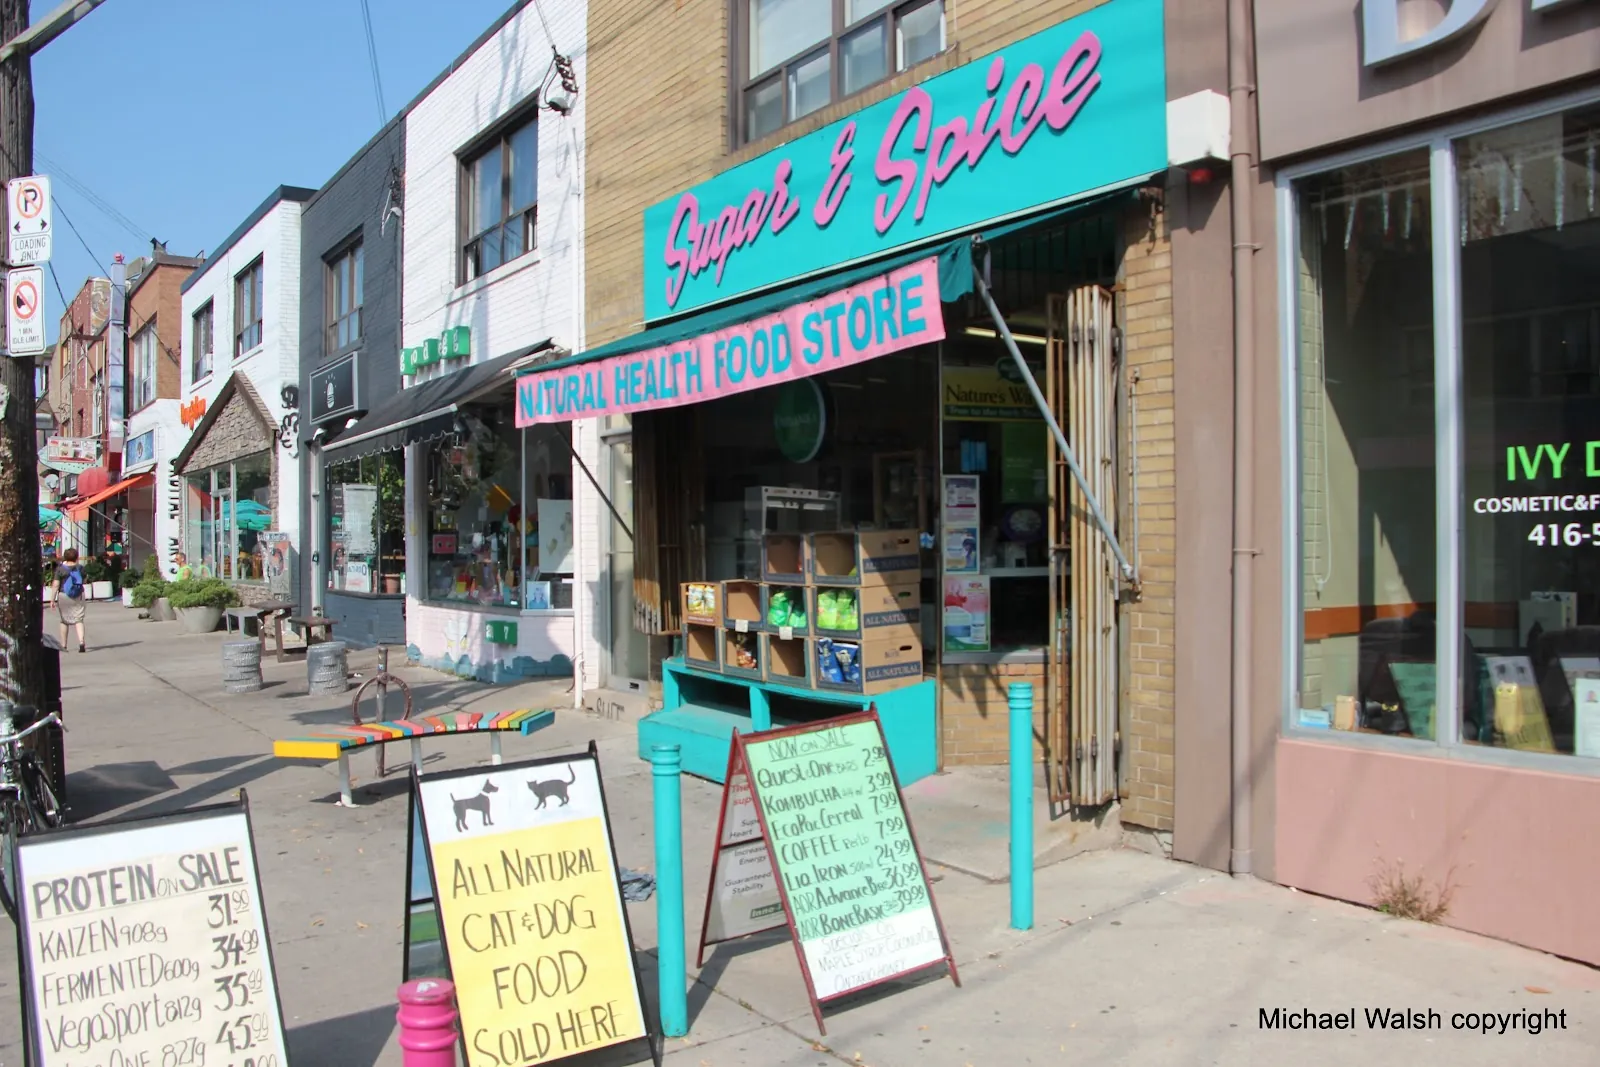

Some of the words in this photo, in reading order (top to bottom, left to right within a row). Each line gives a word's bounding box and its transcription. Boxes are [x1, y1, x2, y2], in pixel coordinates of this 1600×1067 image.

[665, 157, 800, 309] Sugar
[874, 29, 1102, 234] Spice
[14, 236, 46, 251] LOADING
[21, 250, 40, 262] ONLY
[12, 336, 24, 344] IDLE
[25, 335, 40, 344] LIMIT
[518, 369, 606, 420] NATURAL
[614, 348, 703, 406] HEALTH
[714, 322, 791, 388] FOOD
[802, 273, 927, 365] STORE
[946, 383, 1006, 404] Nature's
[1507, 442, 1571, 481] IVY
[866, 772, 892, 794] 3.99
[869, 792, 897, 816] 7.99
[739, 855, 767, 866] Energy
[781, 834, 841, 865] COFFEE
[875, 817, 903, 840] 7.99
[32, 863, 157, 918] PROTEIN
[178, 846, 243, 892] SALE
[453, 859, 504, 899] ALL
[500, 847, 602, 890] NATURAL
[725, 871, 772, 886] Guaranteed
[732, 883, 764, 895] Stability
[812, 863, 848, 883] IRON
[39, 915, 119, 962] KAIZEN
[207, 889, 250, 929] 31.99
[462, 909, 517, 953] CAT
[533, 894, 597, 940] DOG
[43, 953, 164, 1008] FERMENTED
[211, 929, 259, 970] 34.99
[492, 950, 588, 1010] FOOD
[214, 969, 263, 1012] 35.99
[215, 1012, 269, 1055] 45.99
[474, 1022, 549, 1067] SOLD
[556, 1000, 626, 1051] HERE
